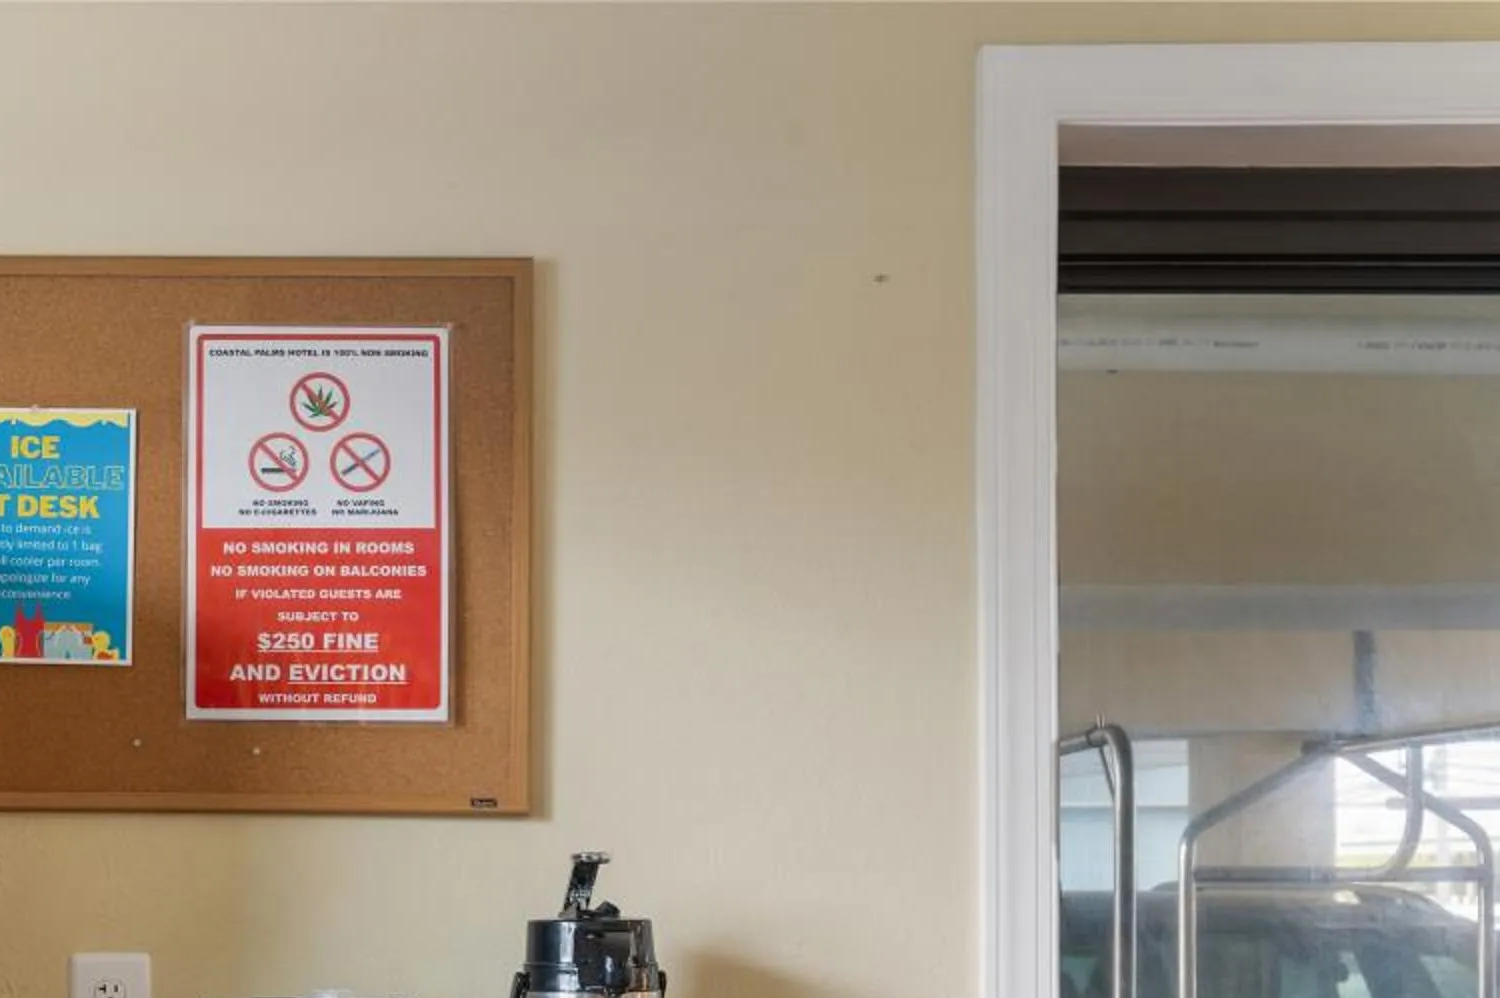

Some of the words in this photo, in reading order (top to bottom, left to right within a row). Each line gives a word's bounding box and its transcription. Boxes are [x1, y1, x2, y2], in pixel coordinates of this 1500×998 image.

[209, 349, 252, 357] COASTAL
[254, 349, 285, 357] PALMS
[287, 349, 318, 357] HOTEL
[321, 349, 330, 357] IS
[384, 349, 429, 357] SMOKING
[10, 435, 60, 459] ICE
[17, 495, 100, 519] DESK
[1, 523, 12, 533] to
[15, 522, 61, 534] demand
[18, 540, 55, 550] limited
[57, 541, 69, 550] to
[82, 540, 103, 554] bag
[224, 542, 248, 554] NO
[252, 542, 328, 554] SMOKING
[334, 542, 350, 554] IN
[355, 542, 415, 554] ROOMS
[11, 556, 45, 566] cooler
[47, 558, 65, 568] per
[211, 565, 233, 577] NO
[237, 565, 309, 577] SMOKING
[313, 565, 336, 577] ON
[340, 565, 427, 577] BALCONIES
[51, 572, 67, 581] for
[69, 575, 91, 586] any
[235, 589, 247, 599] IF
[251, 589, 315, 599] VIOLATED
[319, 589, 372, 599] GUESTS
[375, 589, 402, 599] ARE
[277, 611, 337, 622] SUBJECT
[340, 611, 359, 621] TO
[257, 632, 314, 650] $250
[323, 633, 379, 650] FINE
[230, 664, 281, 681] AND
[288, 664, 406, 682] EVICTION
[259, 693, 319, 704] WITHOUT
[324, 693, 377, 704] REFUND
